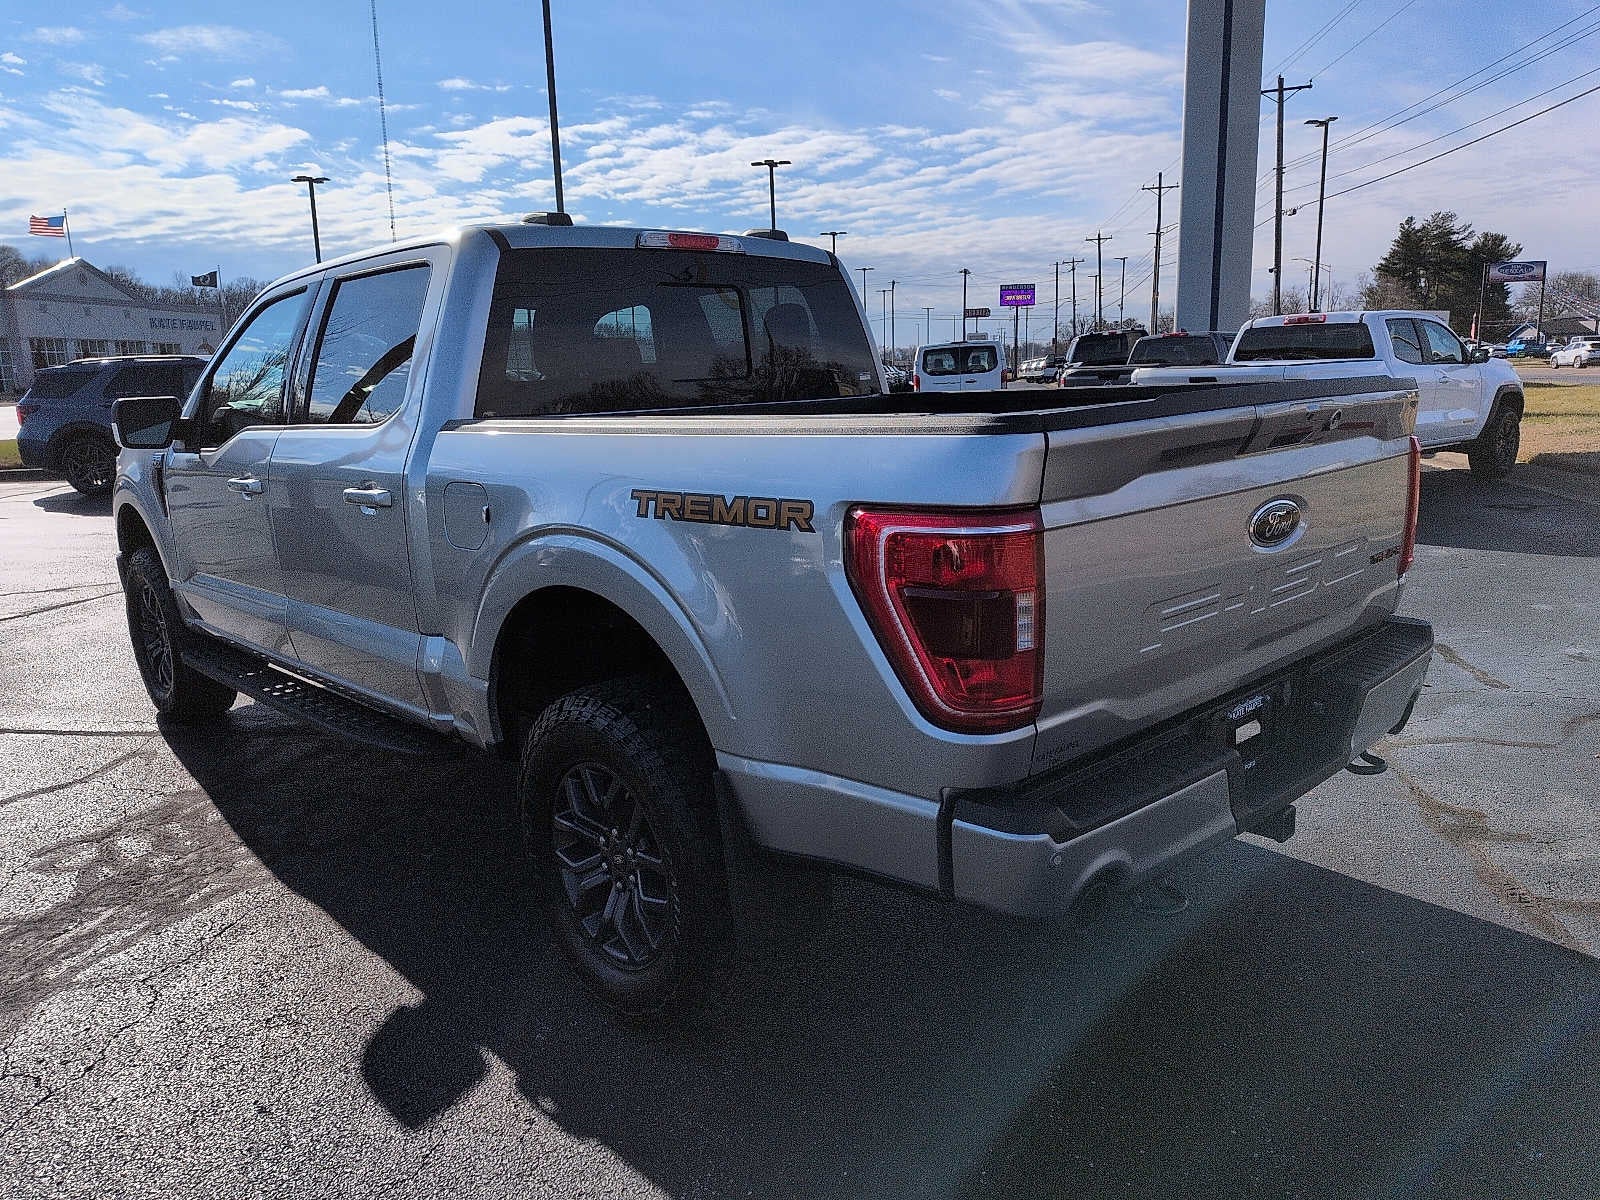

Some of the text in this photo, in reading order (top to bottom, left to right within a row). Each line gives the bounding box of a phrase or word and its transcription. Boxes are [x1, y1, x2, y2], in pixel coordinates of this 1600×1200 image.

[149, 318, 179, 330] KATE
[631, 489, 816, 533] TREMOR
[1265, 509, 1294, 538] Ford
[1232, 706, 1246, 720] KATE
